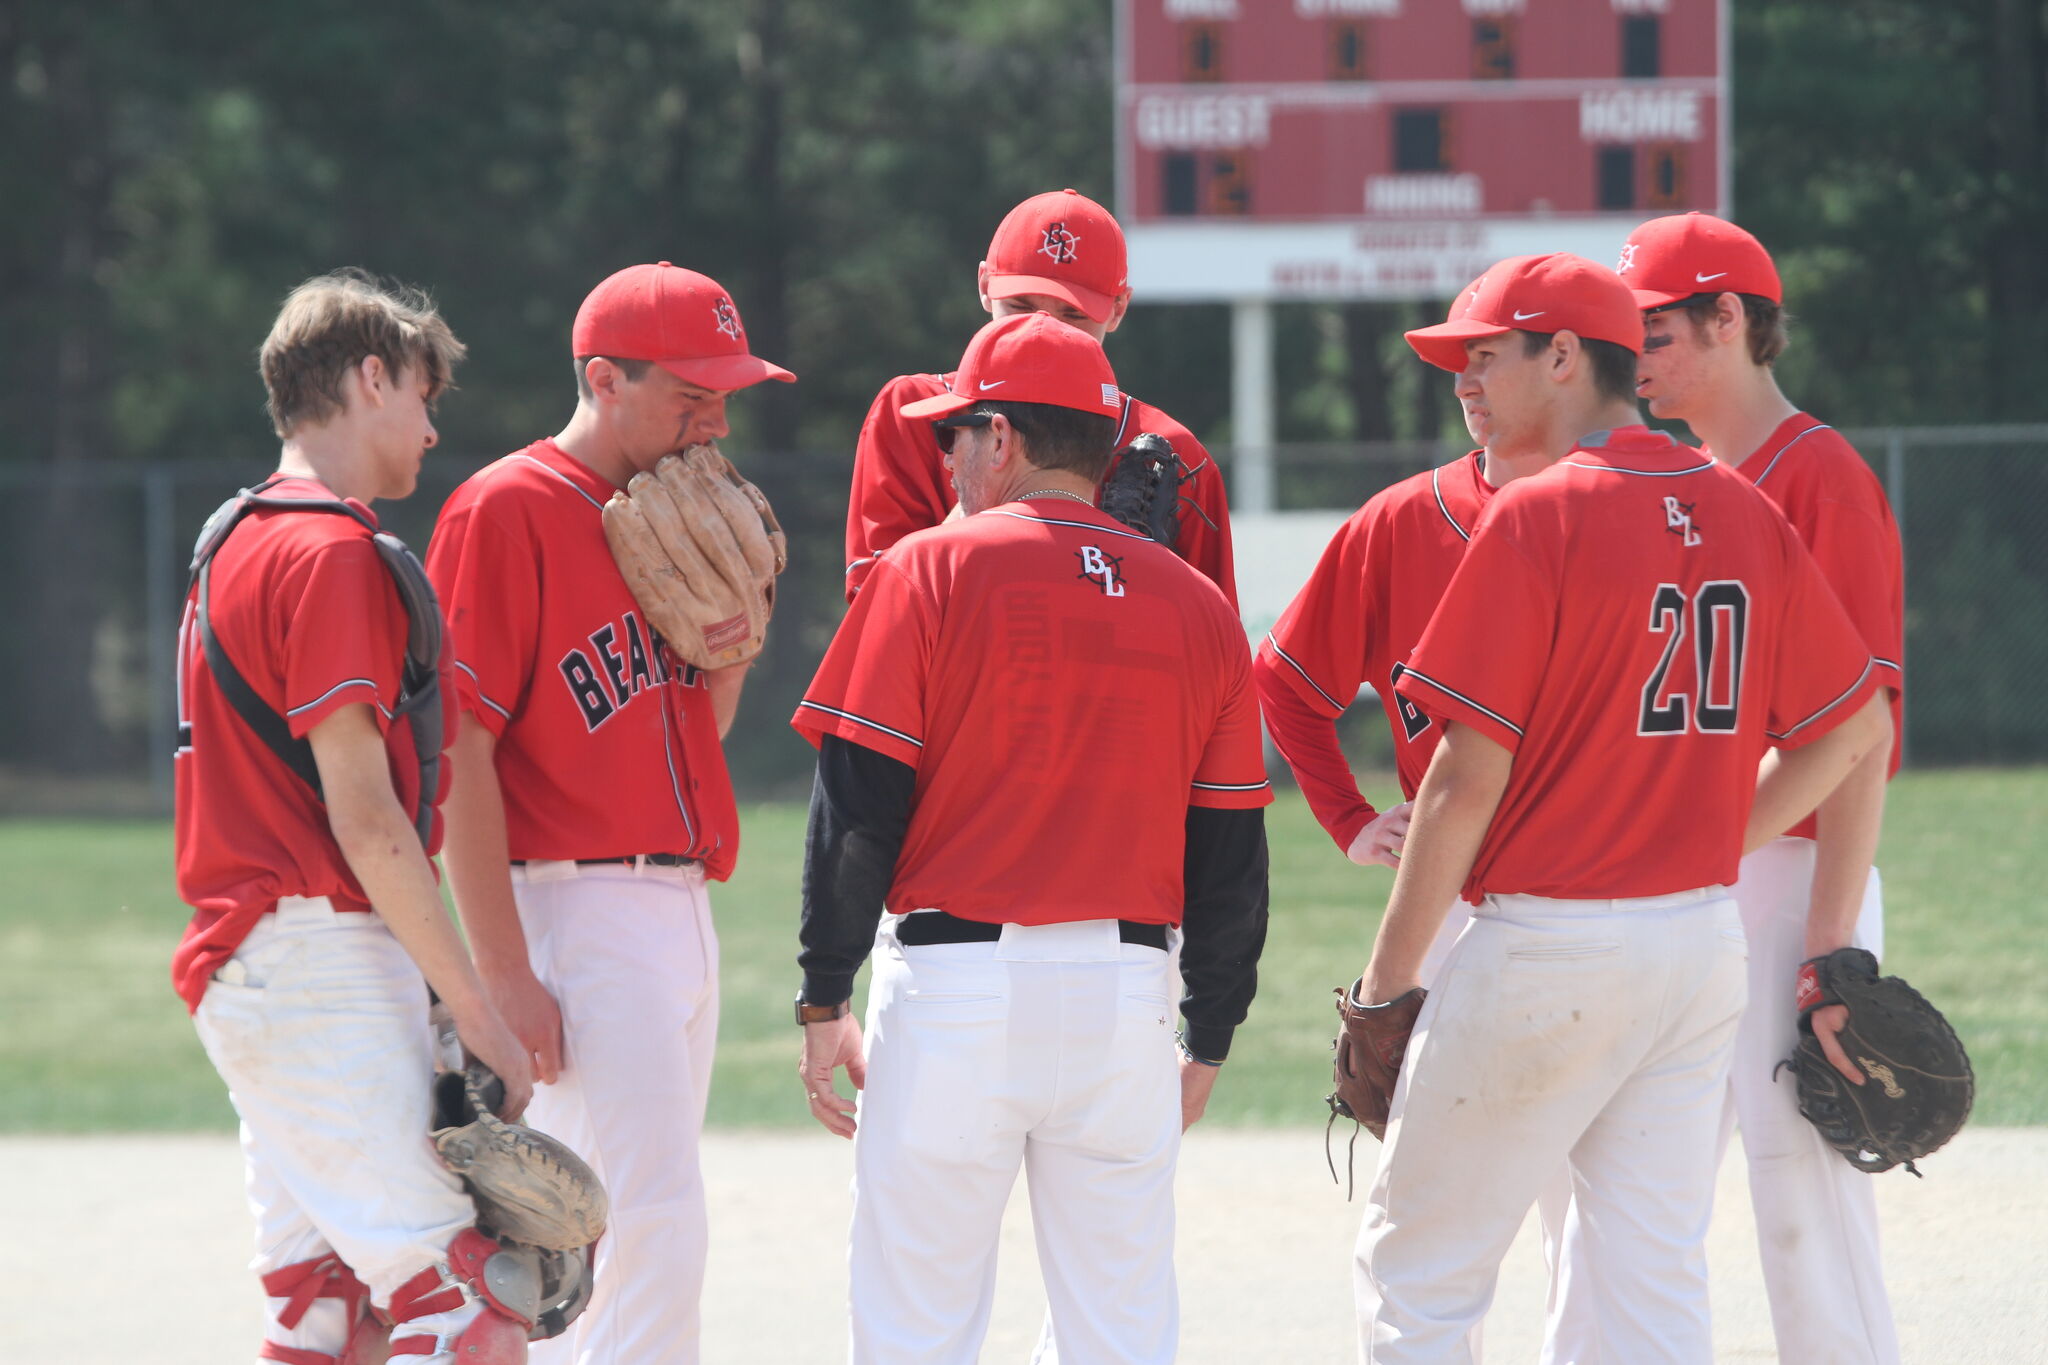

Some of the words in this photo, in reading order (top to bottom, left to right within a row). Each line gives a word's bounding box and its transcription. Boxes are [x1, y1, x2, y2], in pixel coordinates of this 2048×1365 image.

[1138, 97, 1270, 149] GUEST
[1580, 91, 1701, 142] HOME
[1663, 495, 1703, 547] BL
[1080, 545, 1125, 597] BL
[1636, 579, 1752, 736] 20
